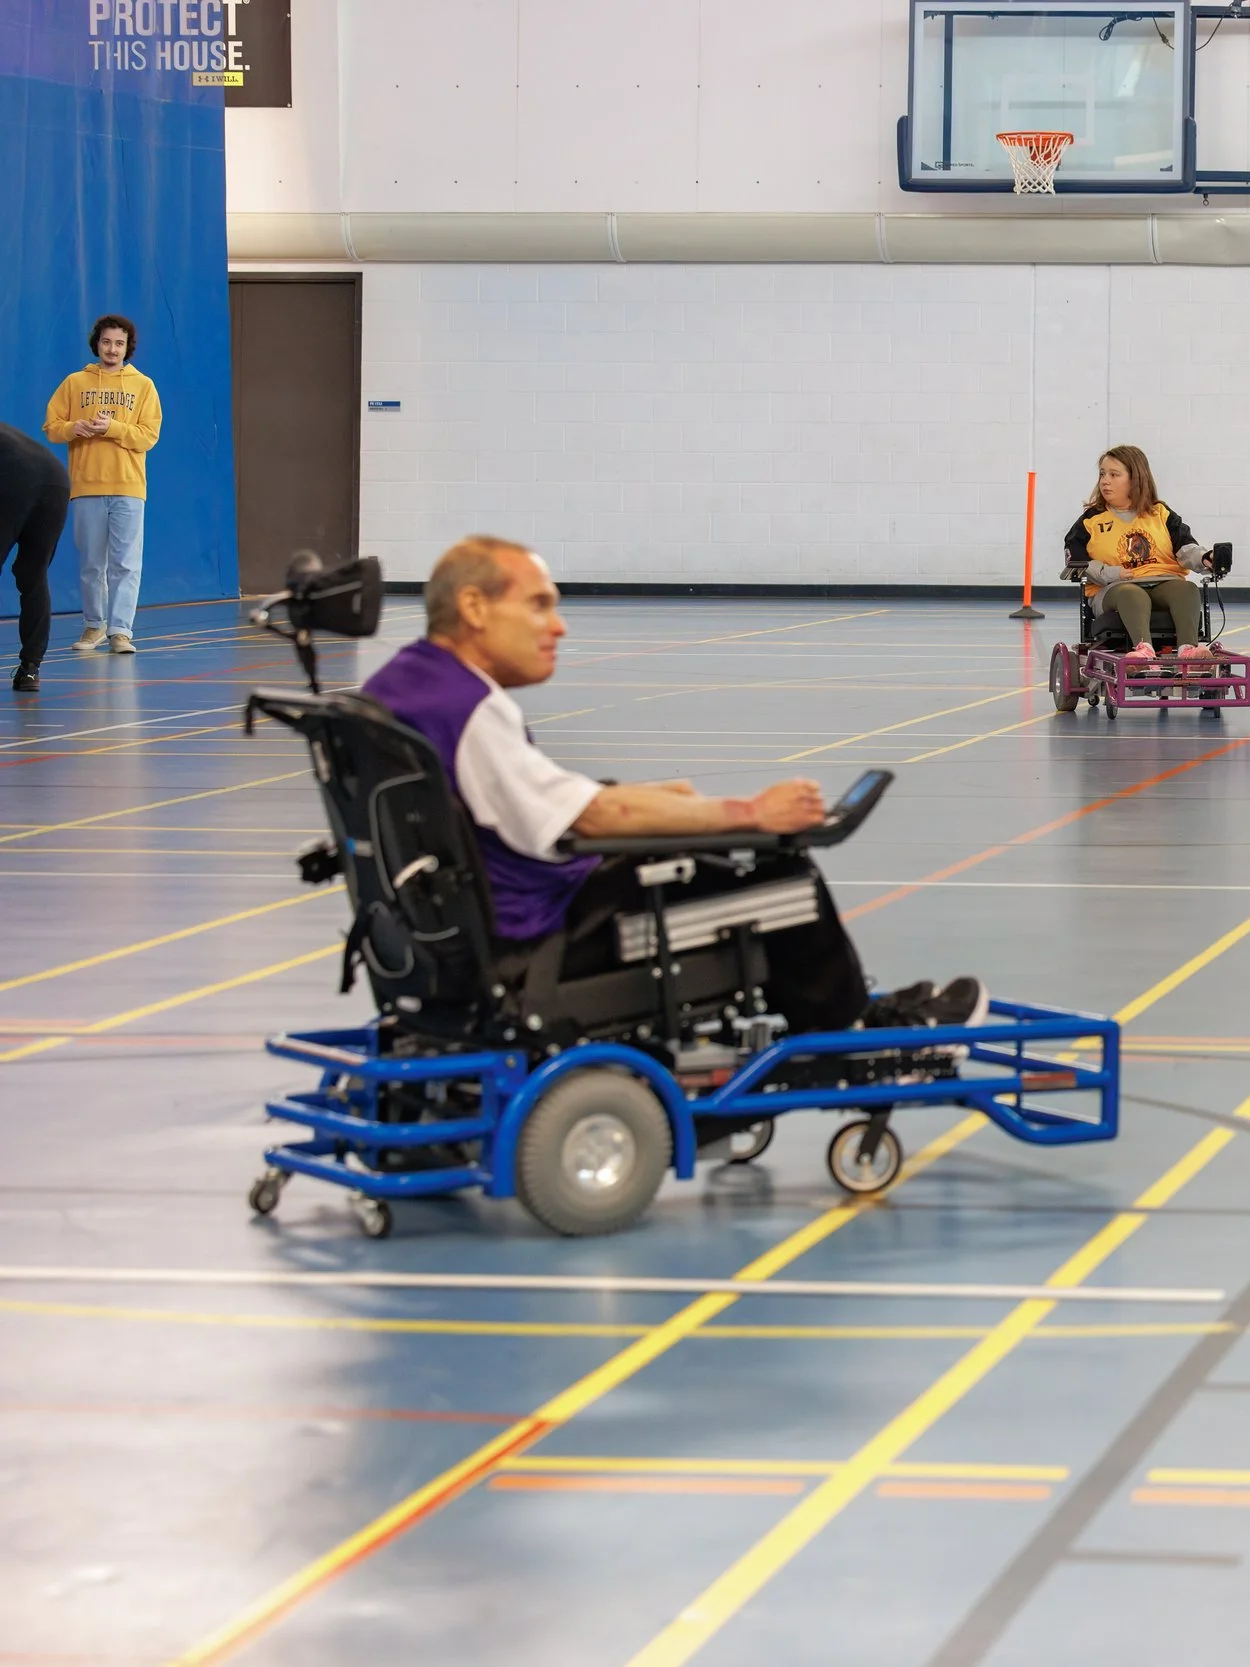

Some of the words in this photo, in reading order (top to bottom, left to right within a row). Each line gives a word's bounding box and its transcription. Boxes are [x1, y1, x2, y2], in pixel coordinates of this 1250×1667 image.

[88, 40, 147, 71] THIS
[155, 40, 250, 71] HOUSE.
[80, 391, 136, 411] LETHBRIDGE
[1097, 520, 1114, 533] 17
